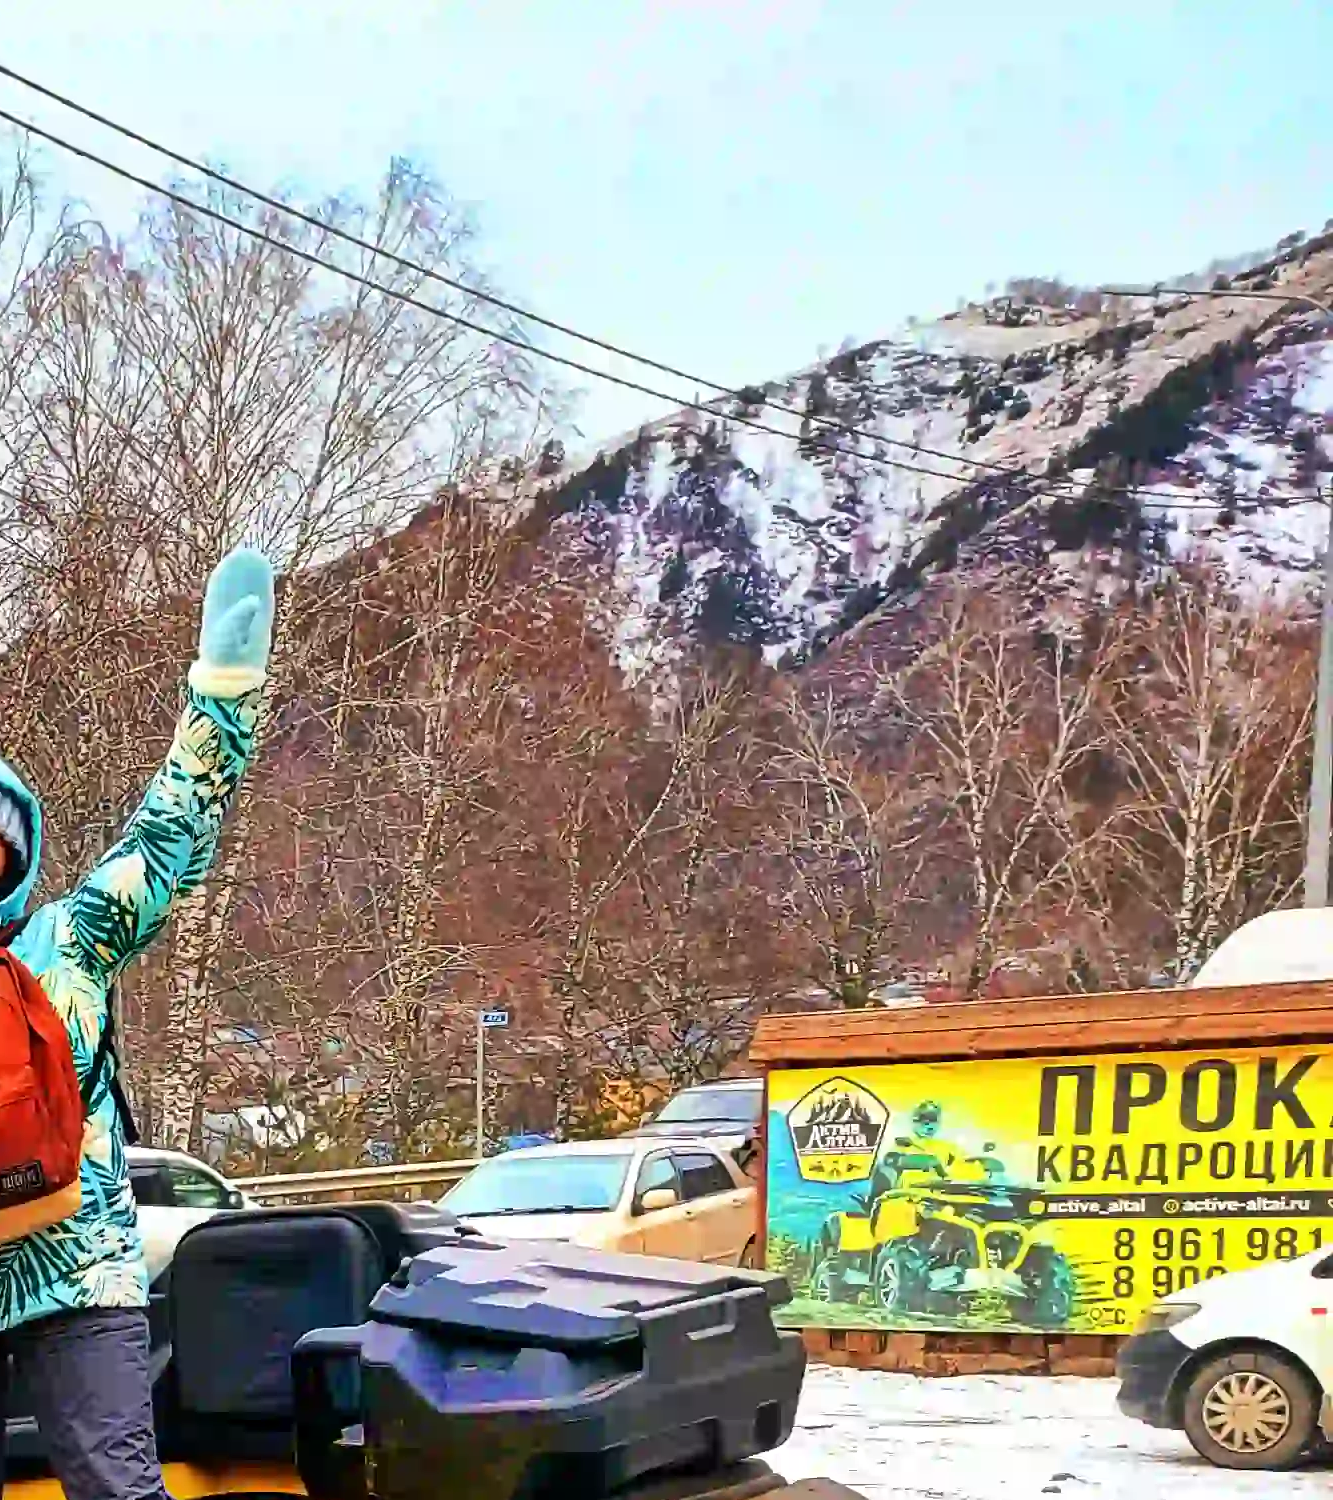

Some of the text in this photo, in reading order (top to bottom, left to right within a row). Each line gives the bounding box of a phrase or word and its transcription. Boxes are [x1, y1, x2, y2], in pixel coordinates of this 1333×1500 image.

[1038, 1055, 1333, 1136] ПРОК
[1182, 1196, 1310, 1212] active-altai.ru
[1114, 1227, 1135, 1261] 8
[1152, 1227, 1225, 1261] 961
[1113, 1265, 1134, 1299] 8
